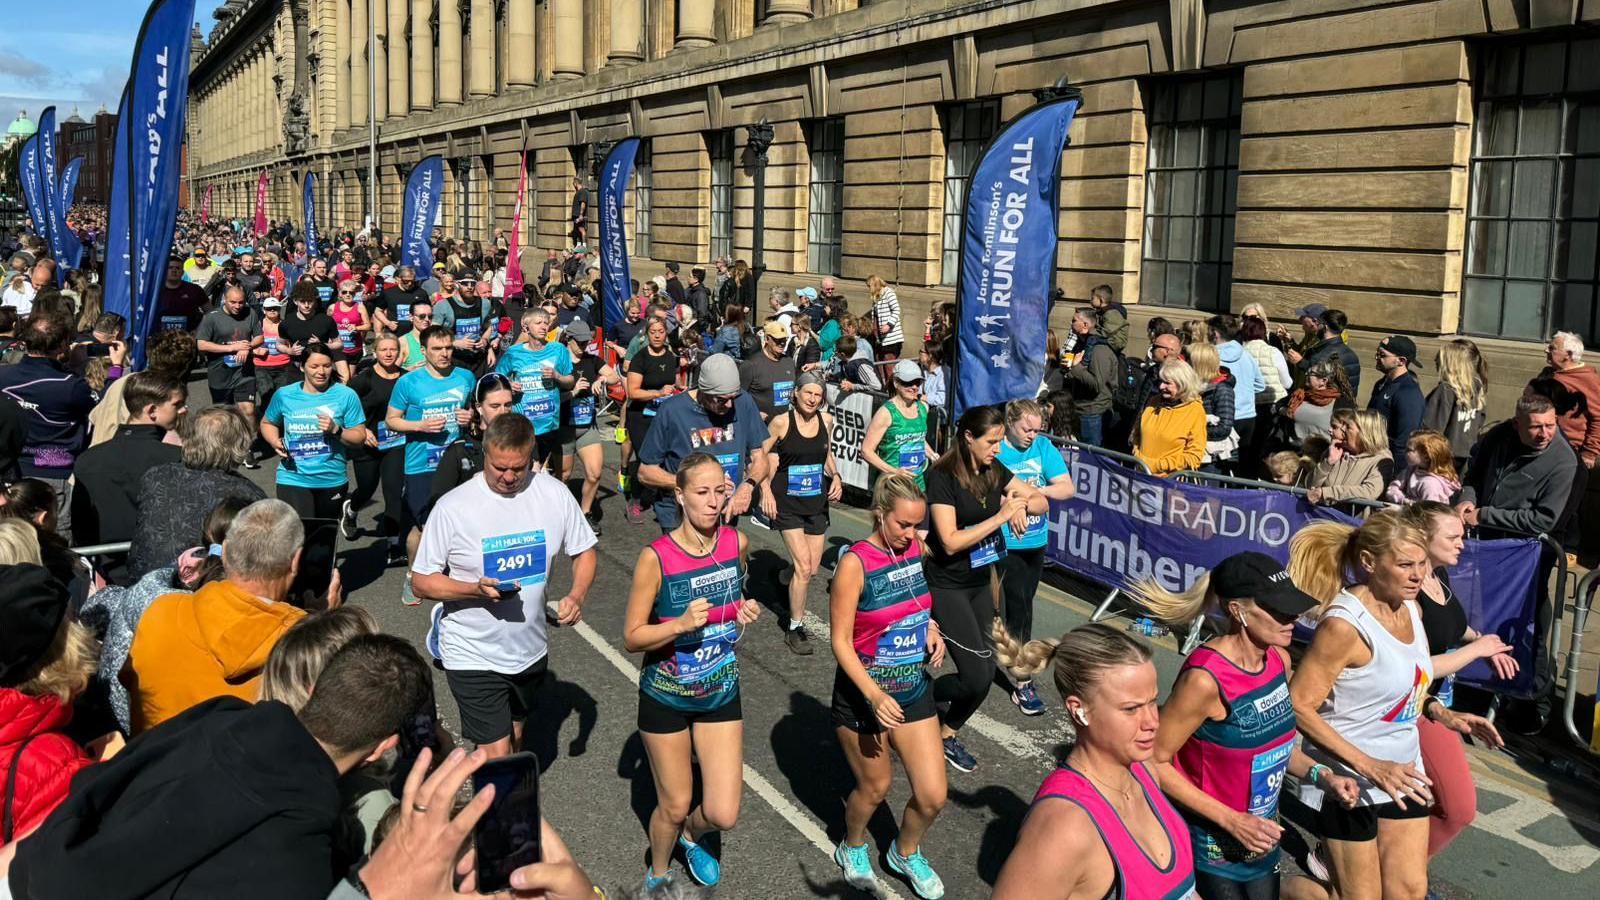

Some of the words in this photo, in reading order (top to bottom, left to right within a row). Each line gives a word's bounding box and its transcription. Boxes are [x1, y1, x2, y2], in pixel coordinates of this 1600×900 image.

[609, 160, 621, 190] ALL
[1009, 137, 1034, 186] ALL
[423, 169, 432, 189] ALL
[420, 191, 430, 214] FOR
[609, 192, 619, 229] FOR
[414, 214, 426, 240] RUN
[982, 181, 1003, 264] Tomlinson's
[999, 192, 1027, 244] FOR
[611, 233, 623, 268] RUN
[977, 269, 990, 304] Jane
[991, 250, 1016, 307] RUN
[827, 405, 865, 430] FEED
[832, 424, 865, 447] OUR
[830, 442, 864, 465] RIVE
[801, 477, 812, 486] 42
[1076, 466, 1159, 520] BBC
[1169, 495, 1290, 546] RADIO
[496, 553, 532, 572] 2491
[1048, 508, 1208, 592] Humber
[694, 643, 721, 662] 974
[893, 633, 917, 649] 944
